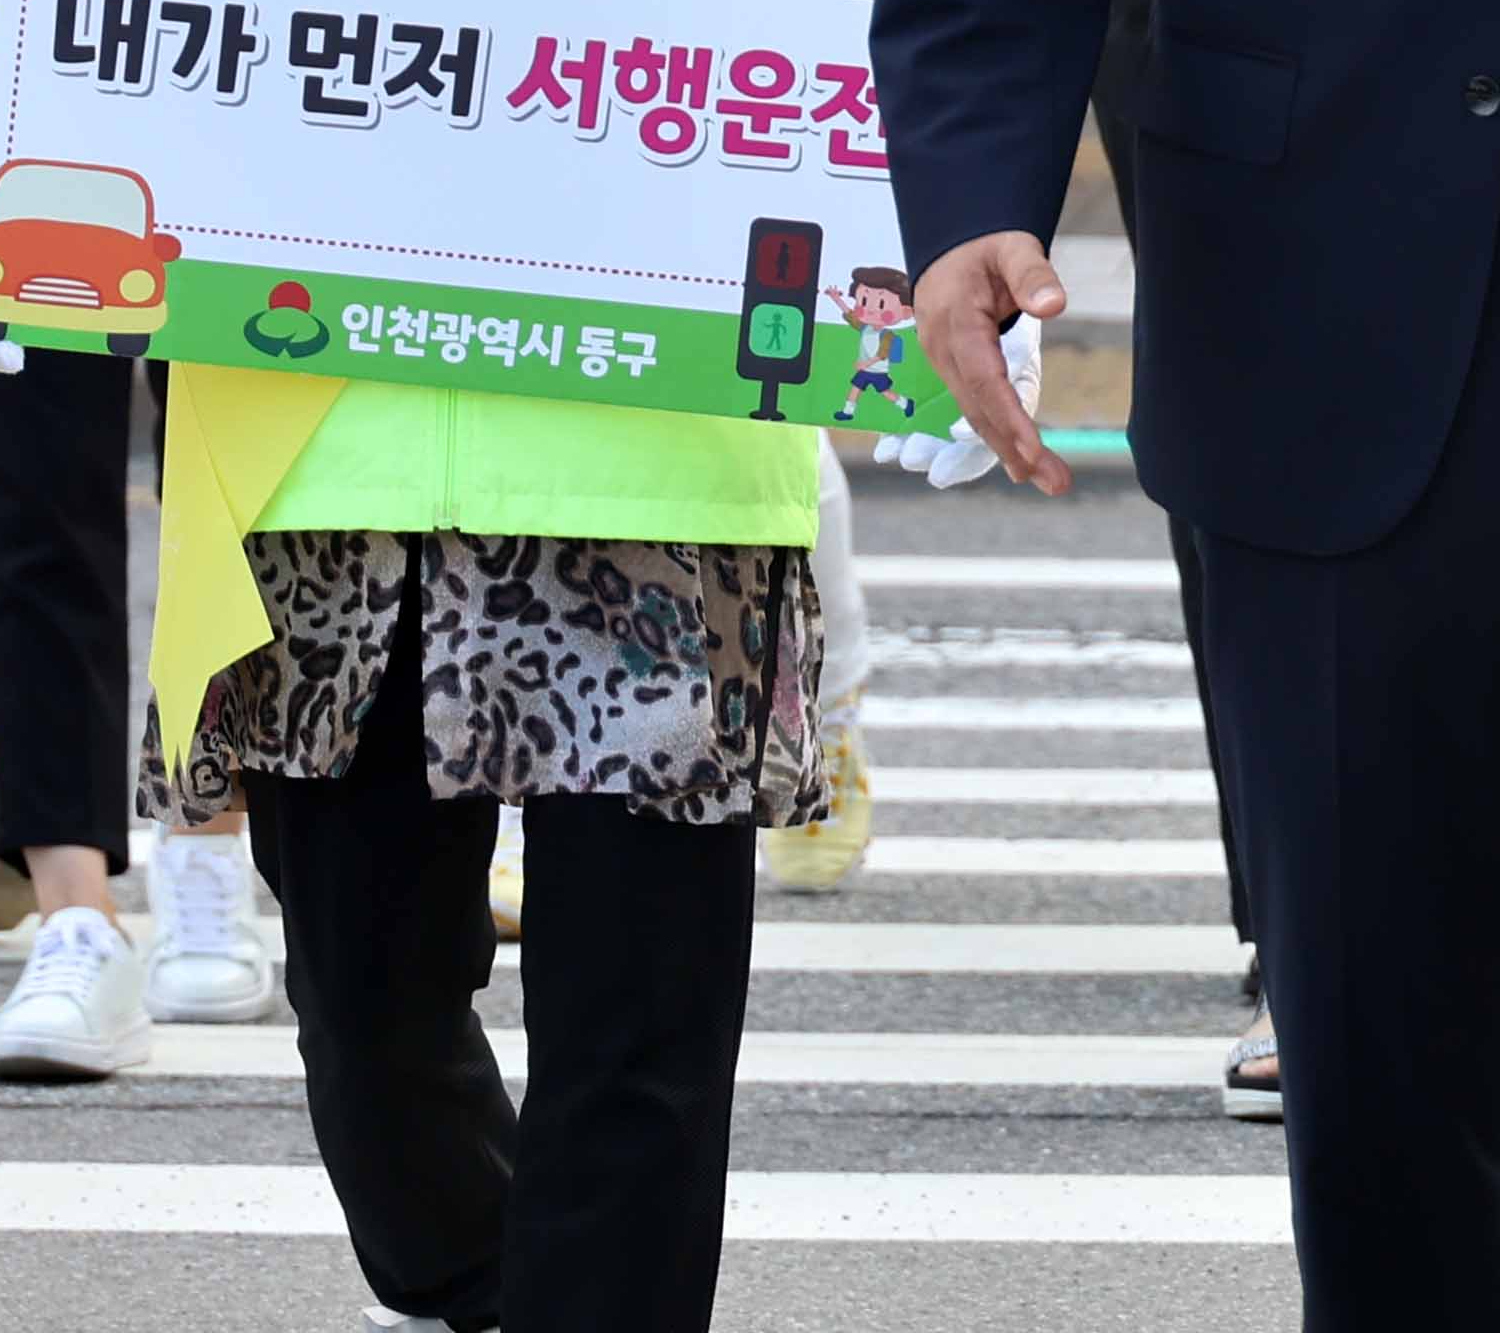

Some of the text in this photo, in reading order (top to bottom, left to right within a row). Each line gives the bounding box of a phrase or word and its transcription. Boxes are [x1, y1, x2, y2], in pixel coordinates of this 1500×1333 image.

[288, 10, 481, 117] 먼저
[341, 303, 658, 378] 인천광역시 동구
